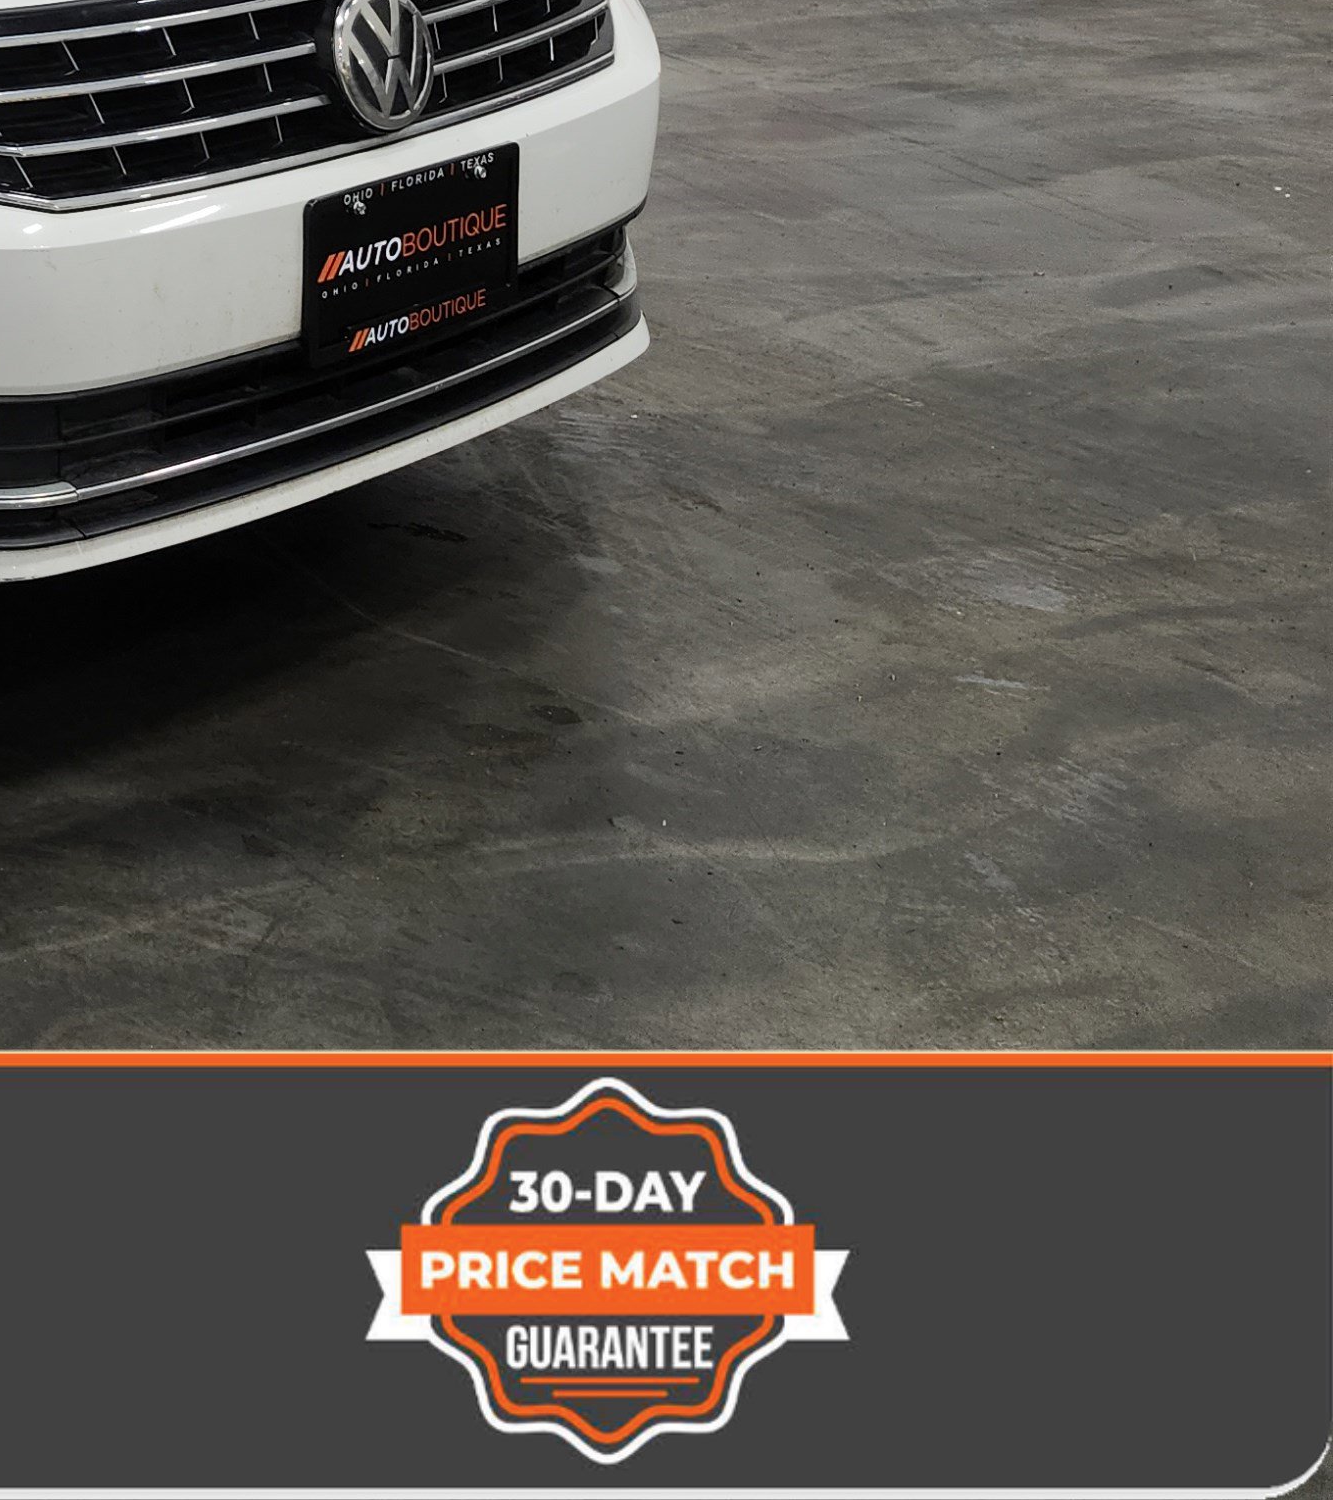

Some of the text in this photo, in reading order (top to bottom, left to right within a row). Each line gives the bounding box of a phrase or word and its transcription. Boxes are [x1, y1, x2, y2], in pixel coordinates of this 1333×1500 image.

[343, 151, 495, 206] OHIO FLORIDA TEXAS
[321, 237, 501, 299] OHIO FLORIDA TEXAS
